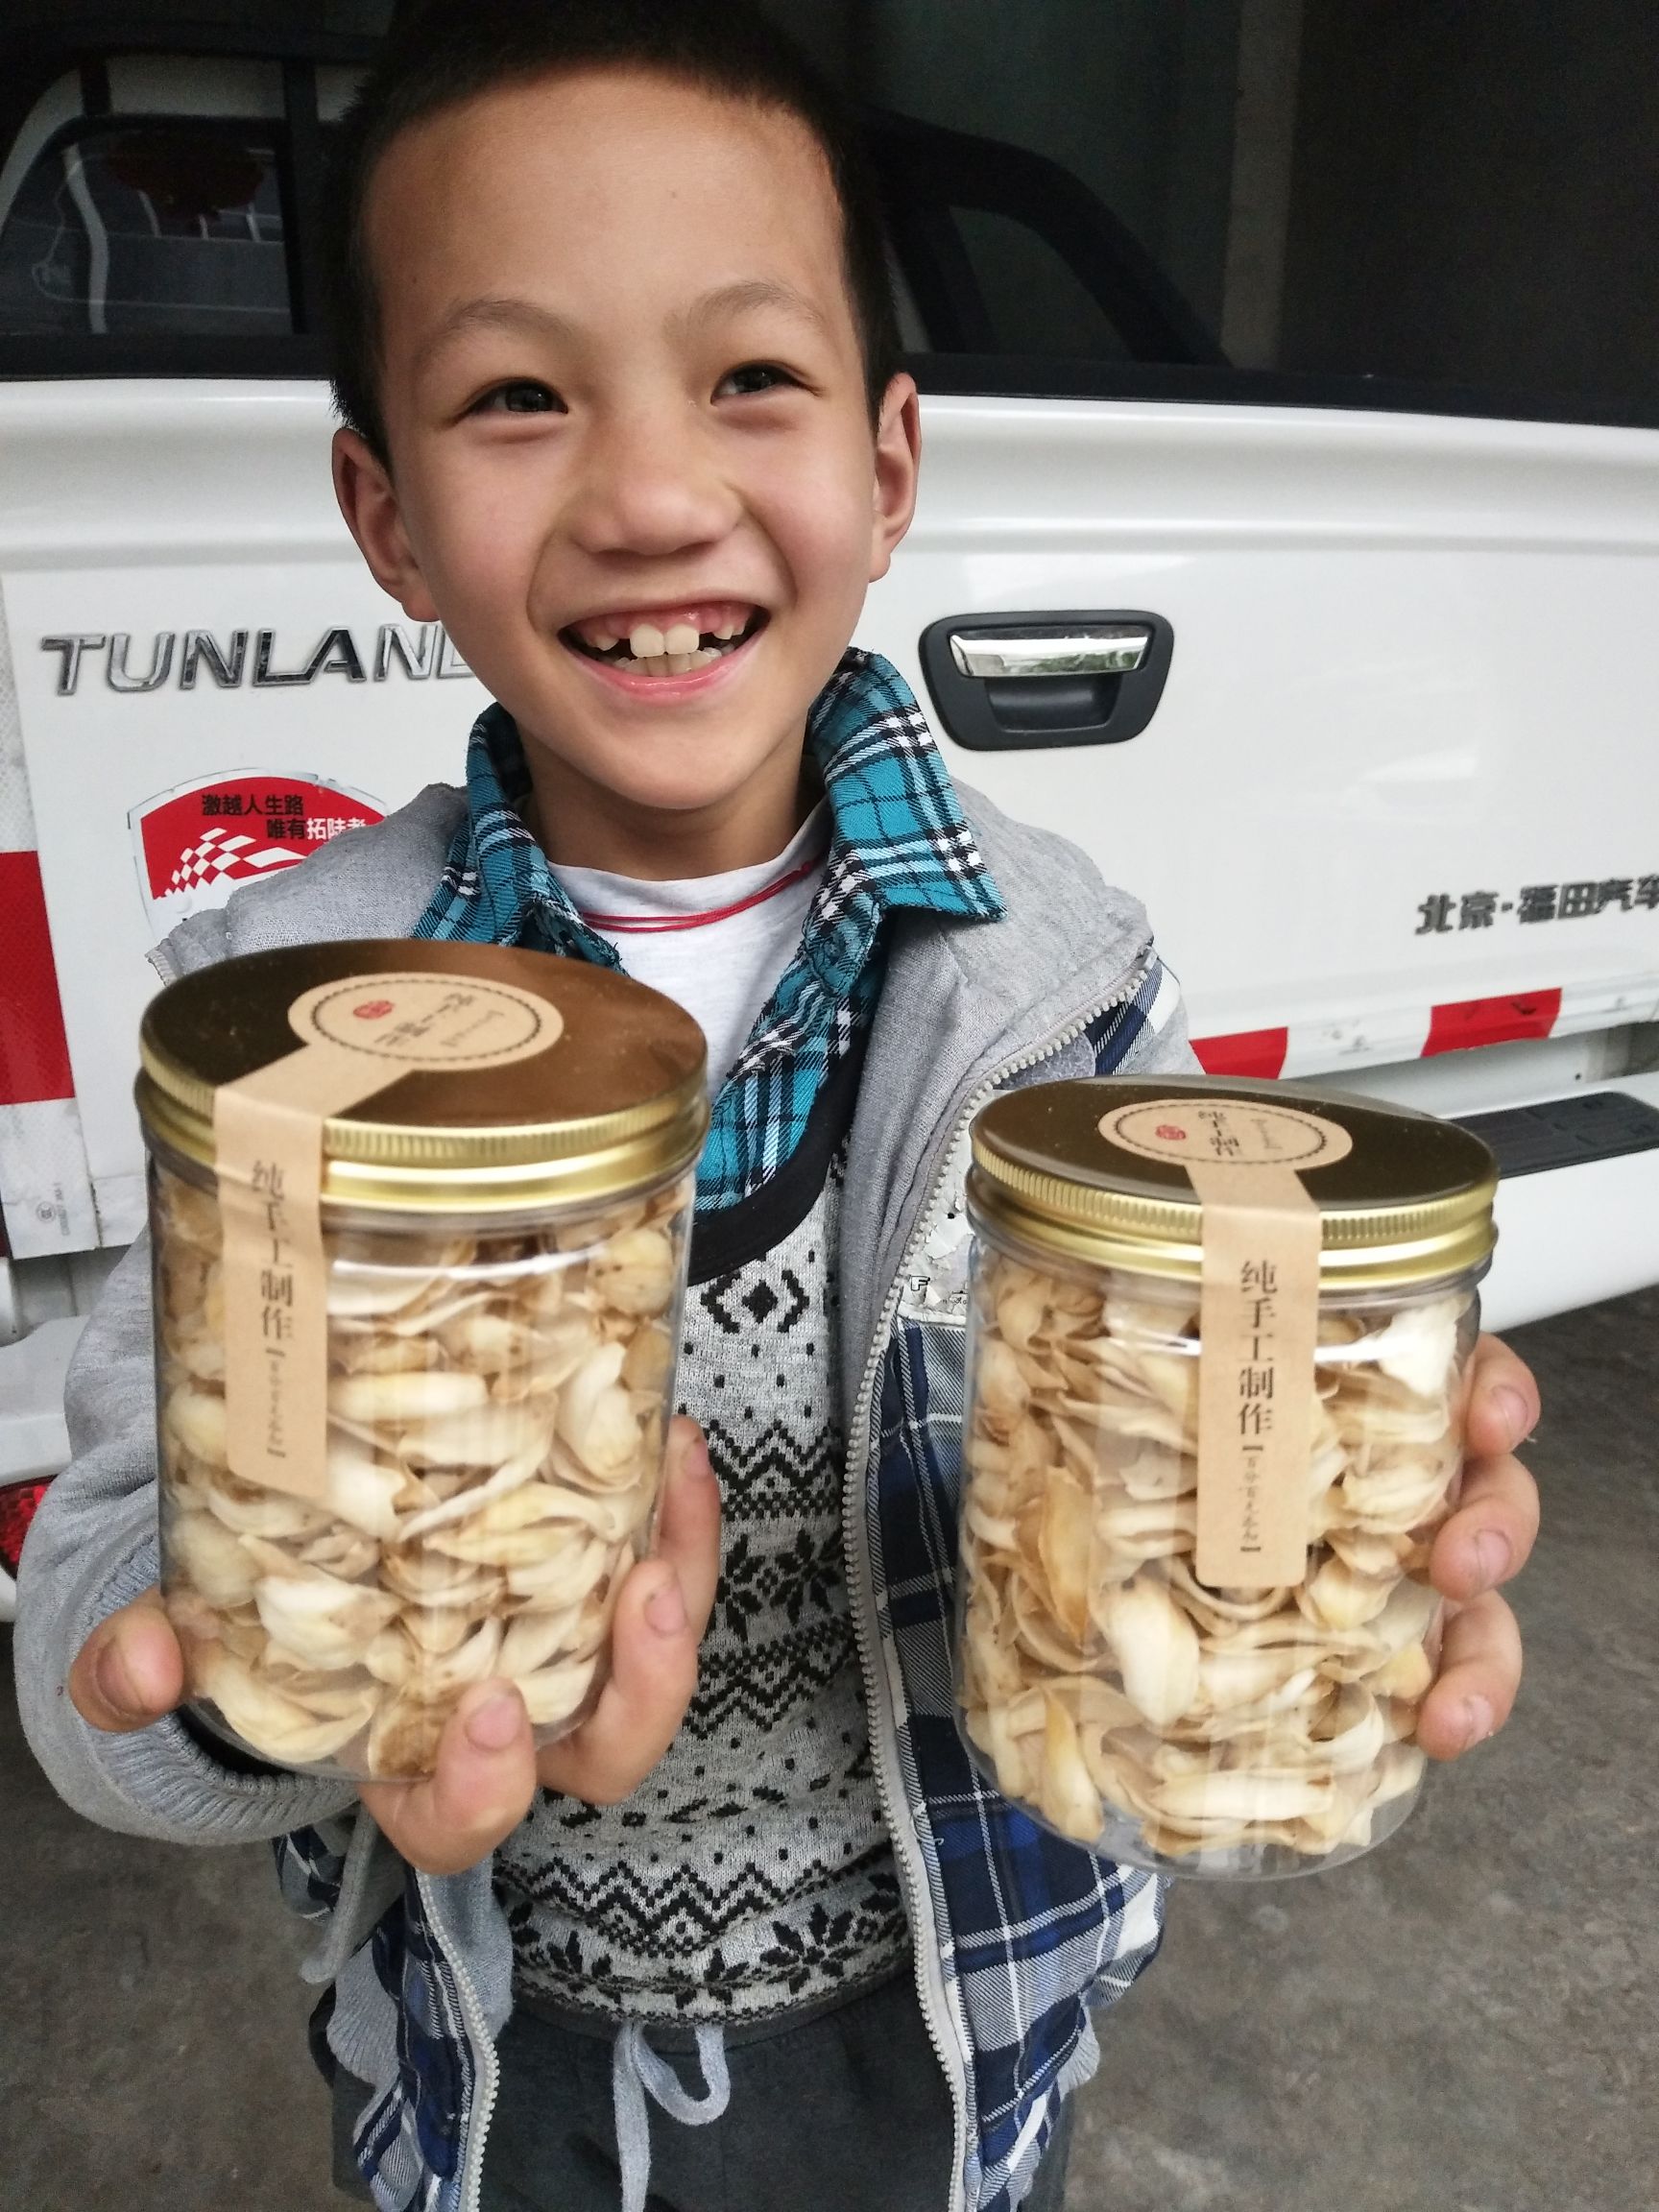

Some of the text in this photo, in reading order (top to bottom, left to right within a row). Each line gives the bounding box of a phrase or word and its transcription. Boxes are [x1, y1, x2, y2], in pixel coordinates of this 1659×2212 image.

[202, 794, 304, 816] 激越人生路
[1237, 1260, 1278, 1435] 纯手工制作
